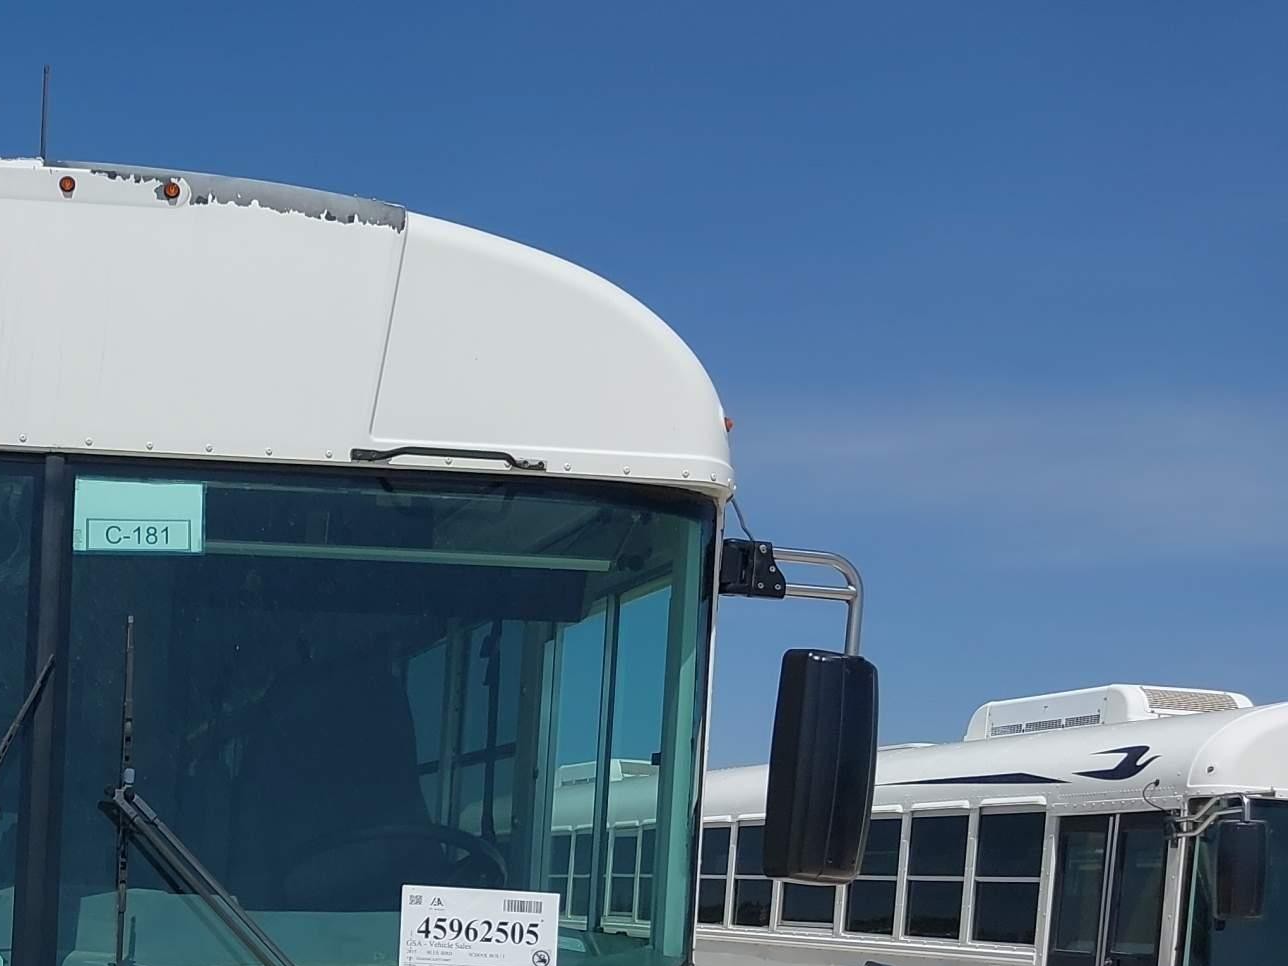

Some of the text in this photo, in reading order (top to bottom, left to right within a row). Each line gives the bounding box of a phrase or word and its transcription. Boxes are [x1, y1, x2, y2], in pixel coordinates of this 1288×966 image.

[105, 525, 169, 545] C-181
[416, 916, 540, 946] 45962505
[429, 941, 453, 949] Vehicle
[455, 942, 472, 950] Sales
